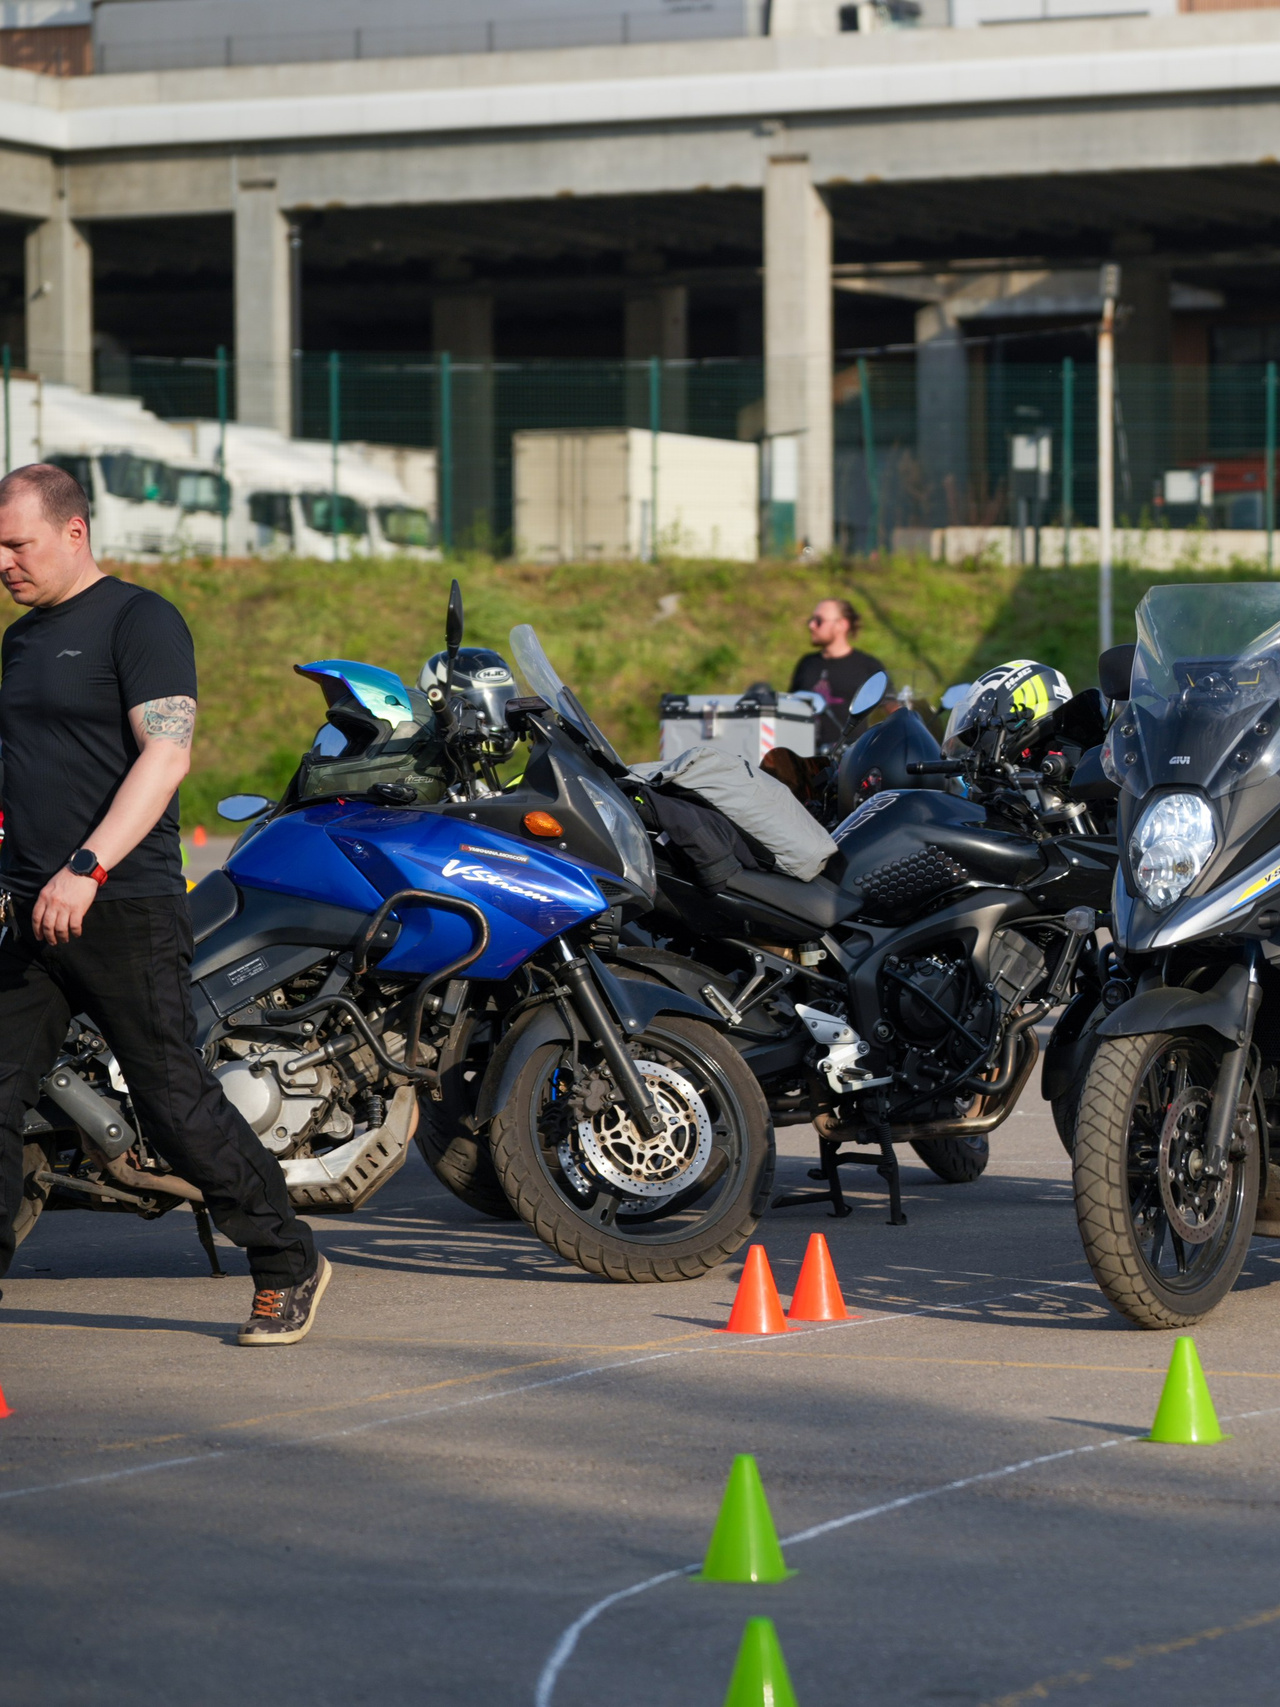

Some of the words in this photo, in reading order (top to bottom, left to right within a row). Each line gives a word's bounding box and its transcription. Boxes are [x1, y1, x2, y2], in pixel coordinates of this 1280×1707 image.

[483, 670, 504, 678] HJC
[1004, 667, 1033, 690] HJC
[1169, 755, 1190, 765] GIVI
